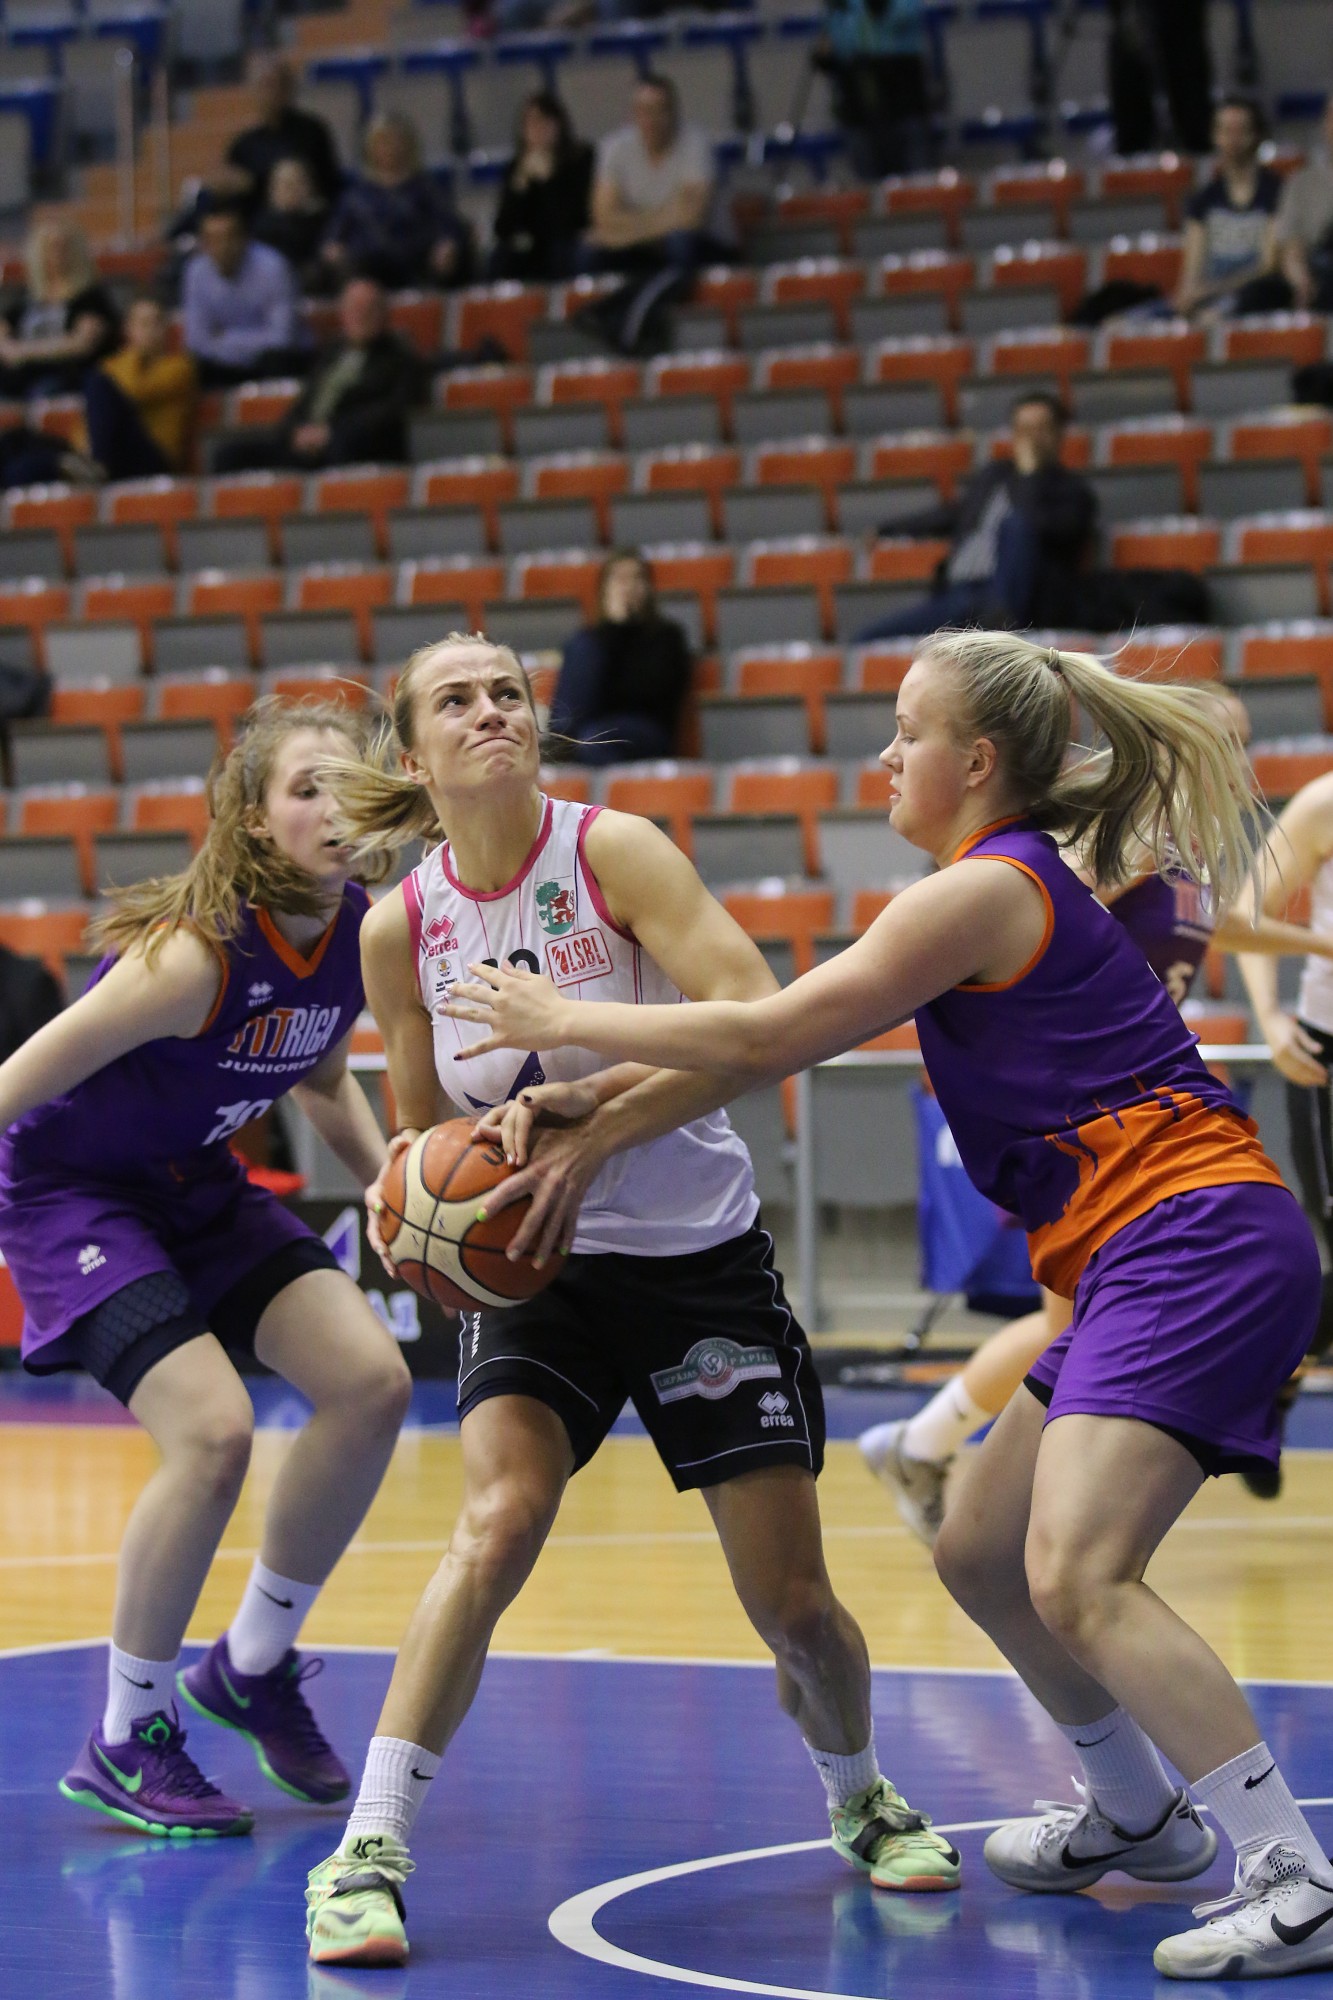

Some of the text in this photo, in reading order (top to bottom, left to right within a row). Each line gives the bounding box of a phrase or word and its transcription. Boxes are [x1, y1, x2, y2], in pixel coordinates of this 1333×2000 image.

[428, 937, 459, 957] errea
[565, 935, 606, 972] LSBL
[217, 1056, 318, 1074] JUNIORES
[82, 1255, 107, 1276] errea
[760, 1414, 795, 1428] errea
